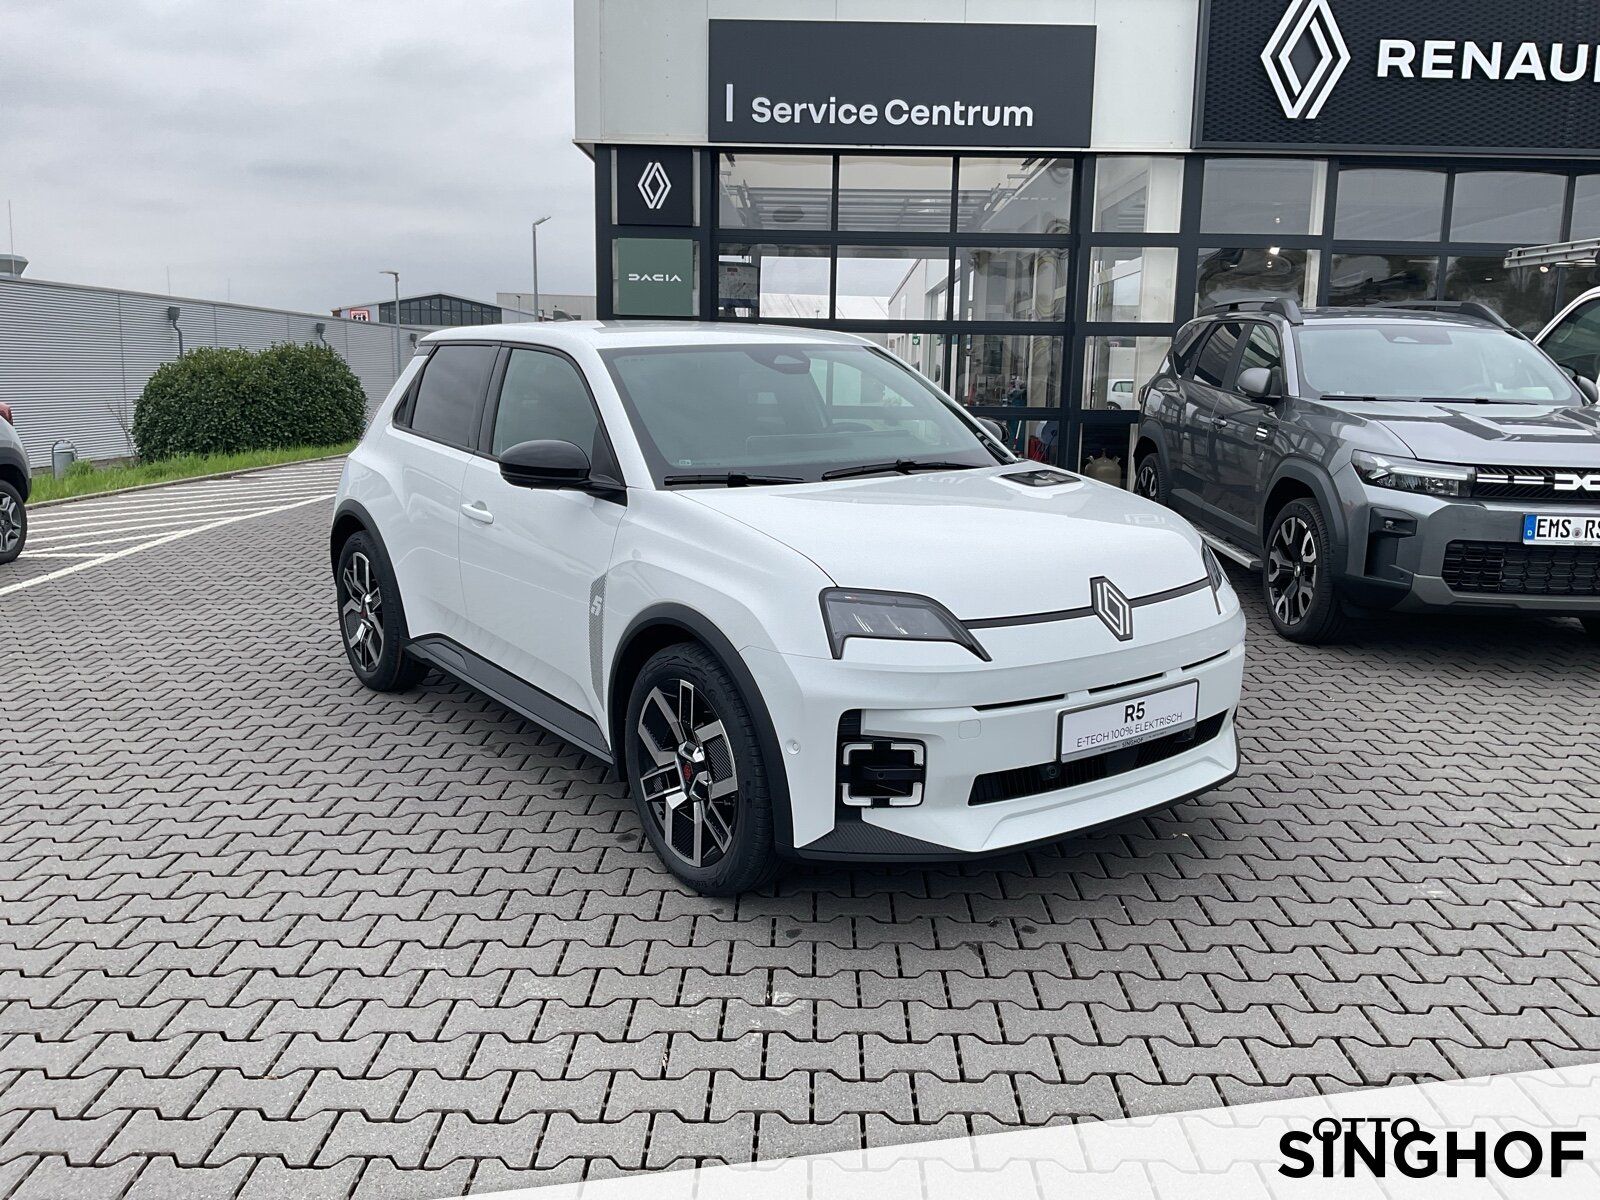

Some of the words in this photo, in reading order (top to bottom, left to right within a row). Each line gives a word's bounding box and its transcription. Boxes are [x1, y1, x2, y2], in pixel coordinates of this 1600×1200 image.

[1377, 39, 1600, 83] RENAU
[751, 96, 878, 125] Service
[885, 99, 1034, 127] Centrum
[628, 273, 682, 282] DACIA
[1536, 518, 1571, 538] EMS
[1124, 701, 1146, 723] R5
[1076, 731, 1110, 748] E-TECH
[1111, 725, 1134, 740] 100%
[1135, 712, 1183, 733] ELEKTRISCH
